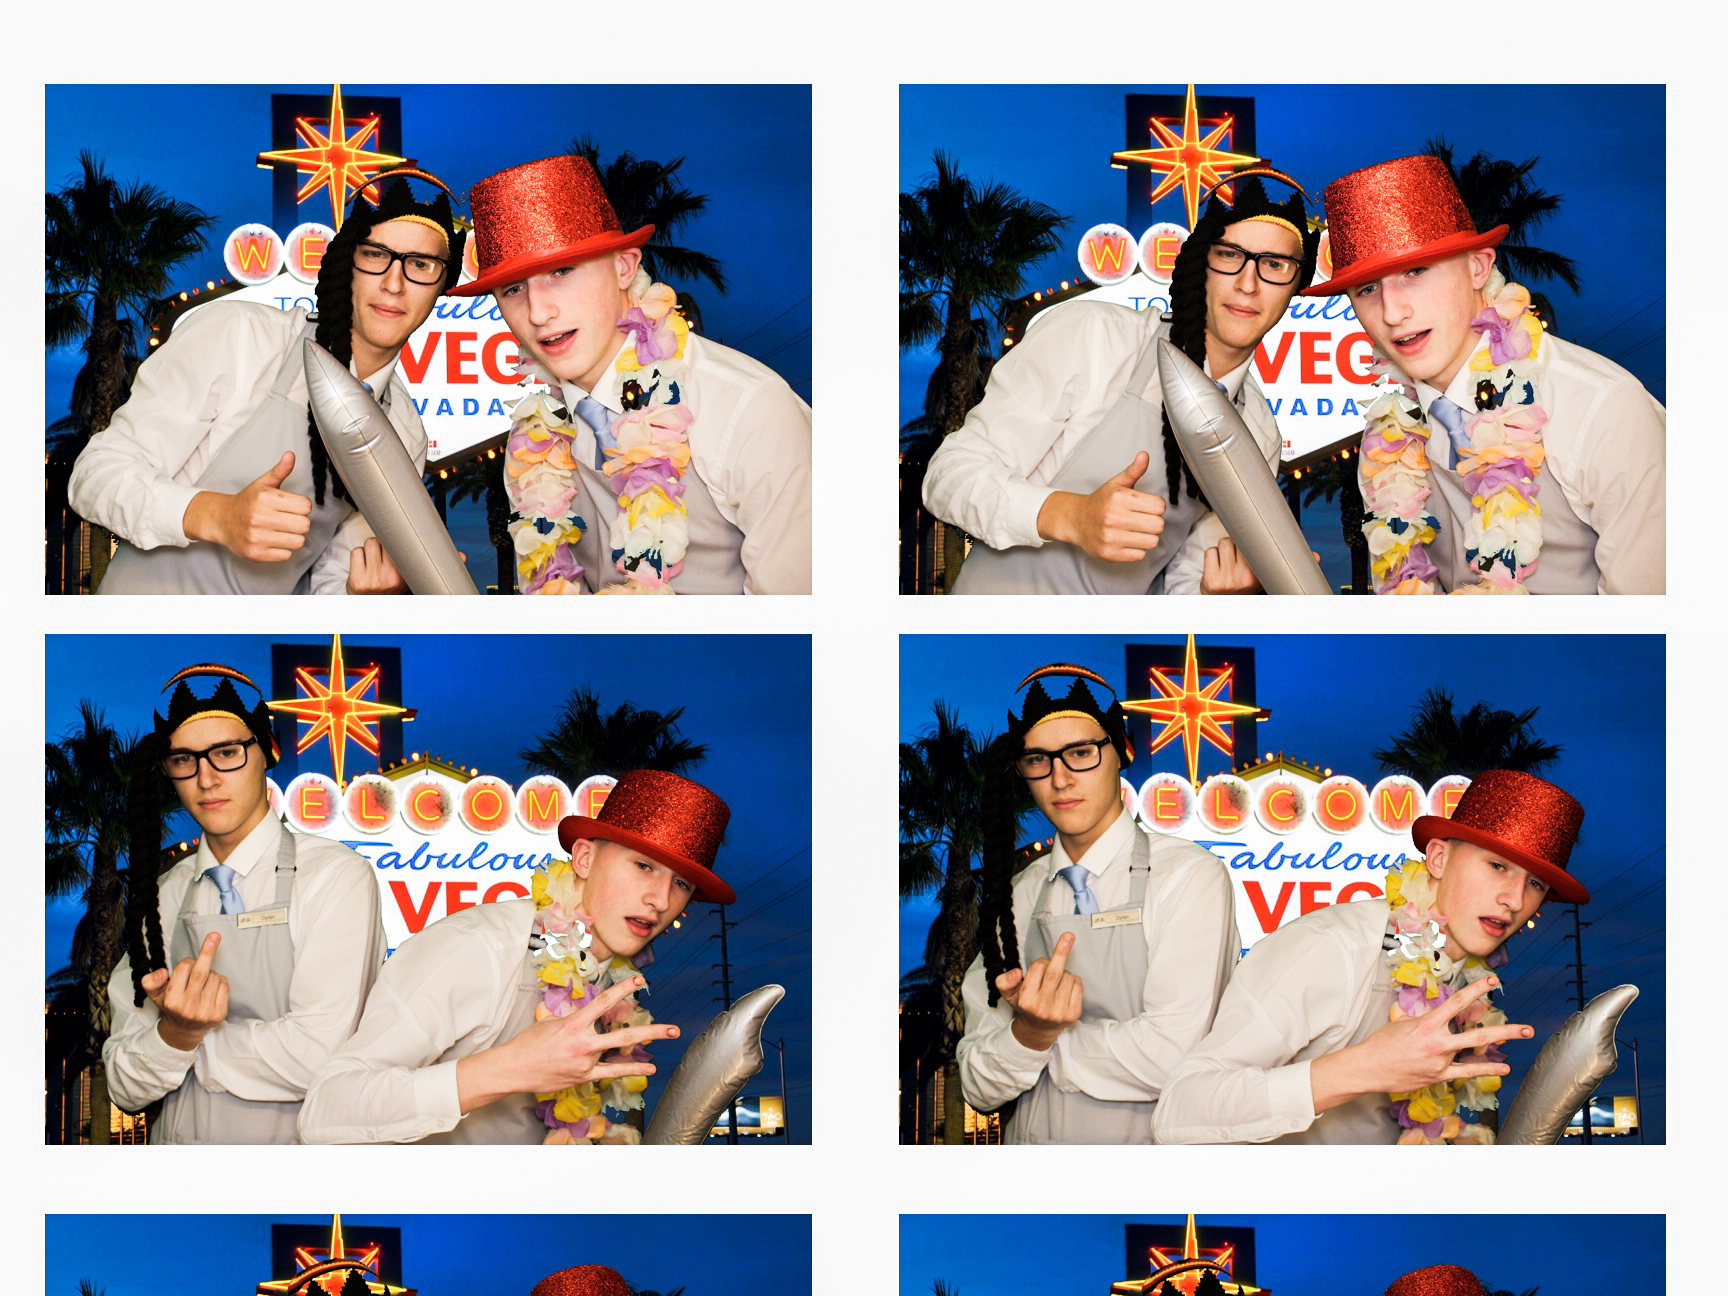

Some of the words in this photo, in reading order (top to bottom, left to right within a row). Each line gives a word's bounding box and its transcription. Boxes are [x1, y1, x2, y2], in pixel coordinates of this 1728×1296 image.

[400, 332, 530, 385] VEG
[1254, 332, 1384, 385] VEG
[412, 397, 505, 416] VADA
[1266, 397, 1359, 416] VADA
[267, 786, 613, 821] ELCOME
[1121, 786, 1467, 821] ELCOME
